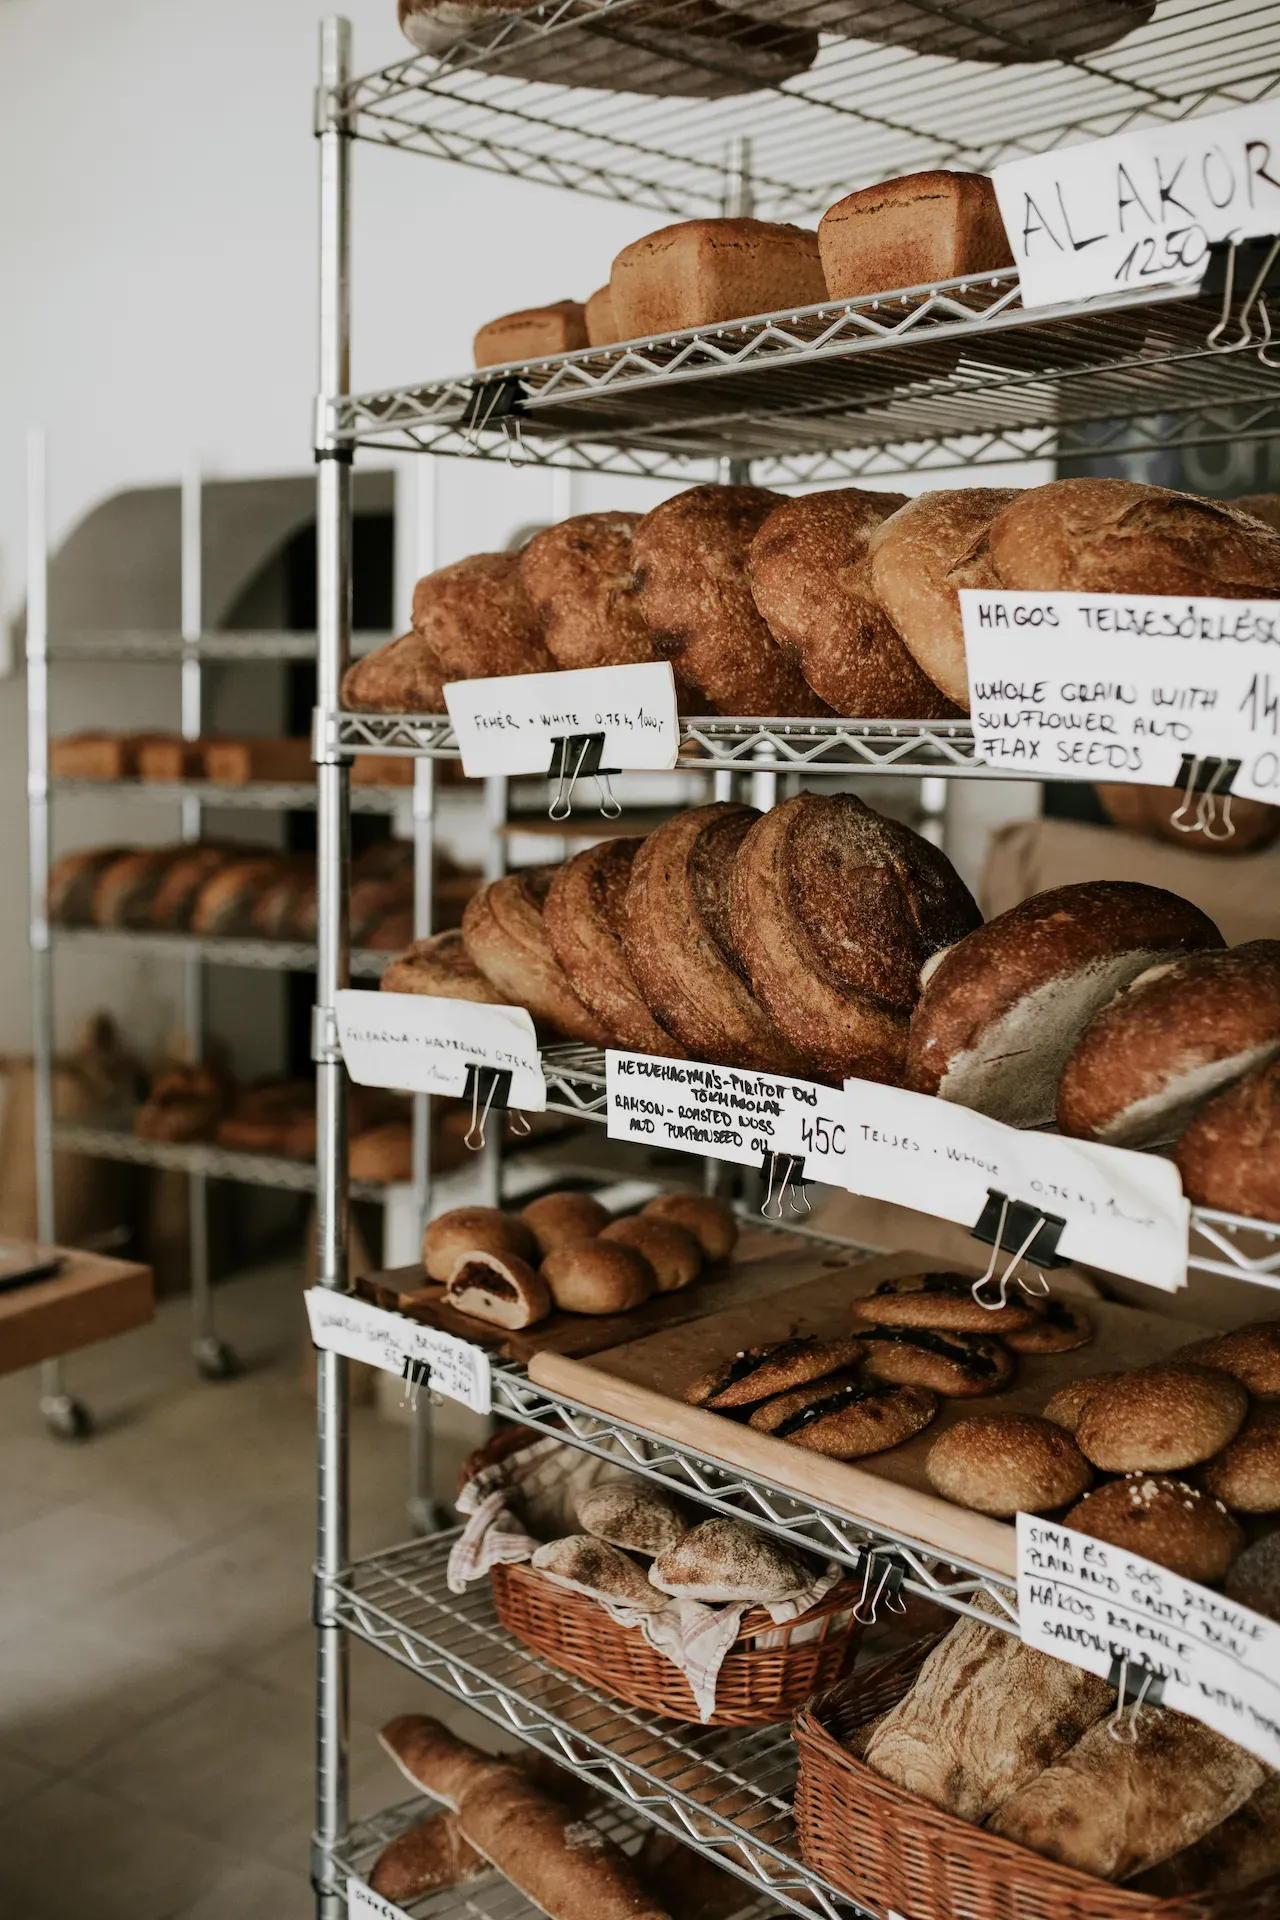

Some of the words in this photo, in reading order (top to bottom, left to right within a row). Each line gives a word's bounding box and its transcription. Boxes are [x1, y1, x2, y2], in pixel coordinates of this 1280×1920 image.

[1114, 224, 1209, 281] 1250
[974, 680, 1051, 703] WHOLE
[1060, 682, 1138, 705] GRAIN
[1151, 688, 1219, 711] WITH
[539, 713, 580, 727] WHITE
[977, 710, 1119, 734] SUNFLOWER
[1133, 717, 1193, 741] AND
[982, 738, 1041, 760] FLAX
[1056, 740, 1144, 771] SEEDS
[629, 1117, 655, 1134] AND
[946, 1145, 1000, 1176] WHOLE
[1027, 1547, 1075, 1574] PLAIN
[1080, 1566, 1120, 1594] AND
[1083, 1543, 1108, 1568] ÉS
